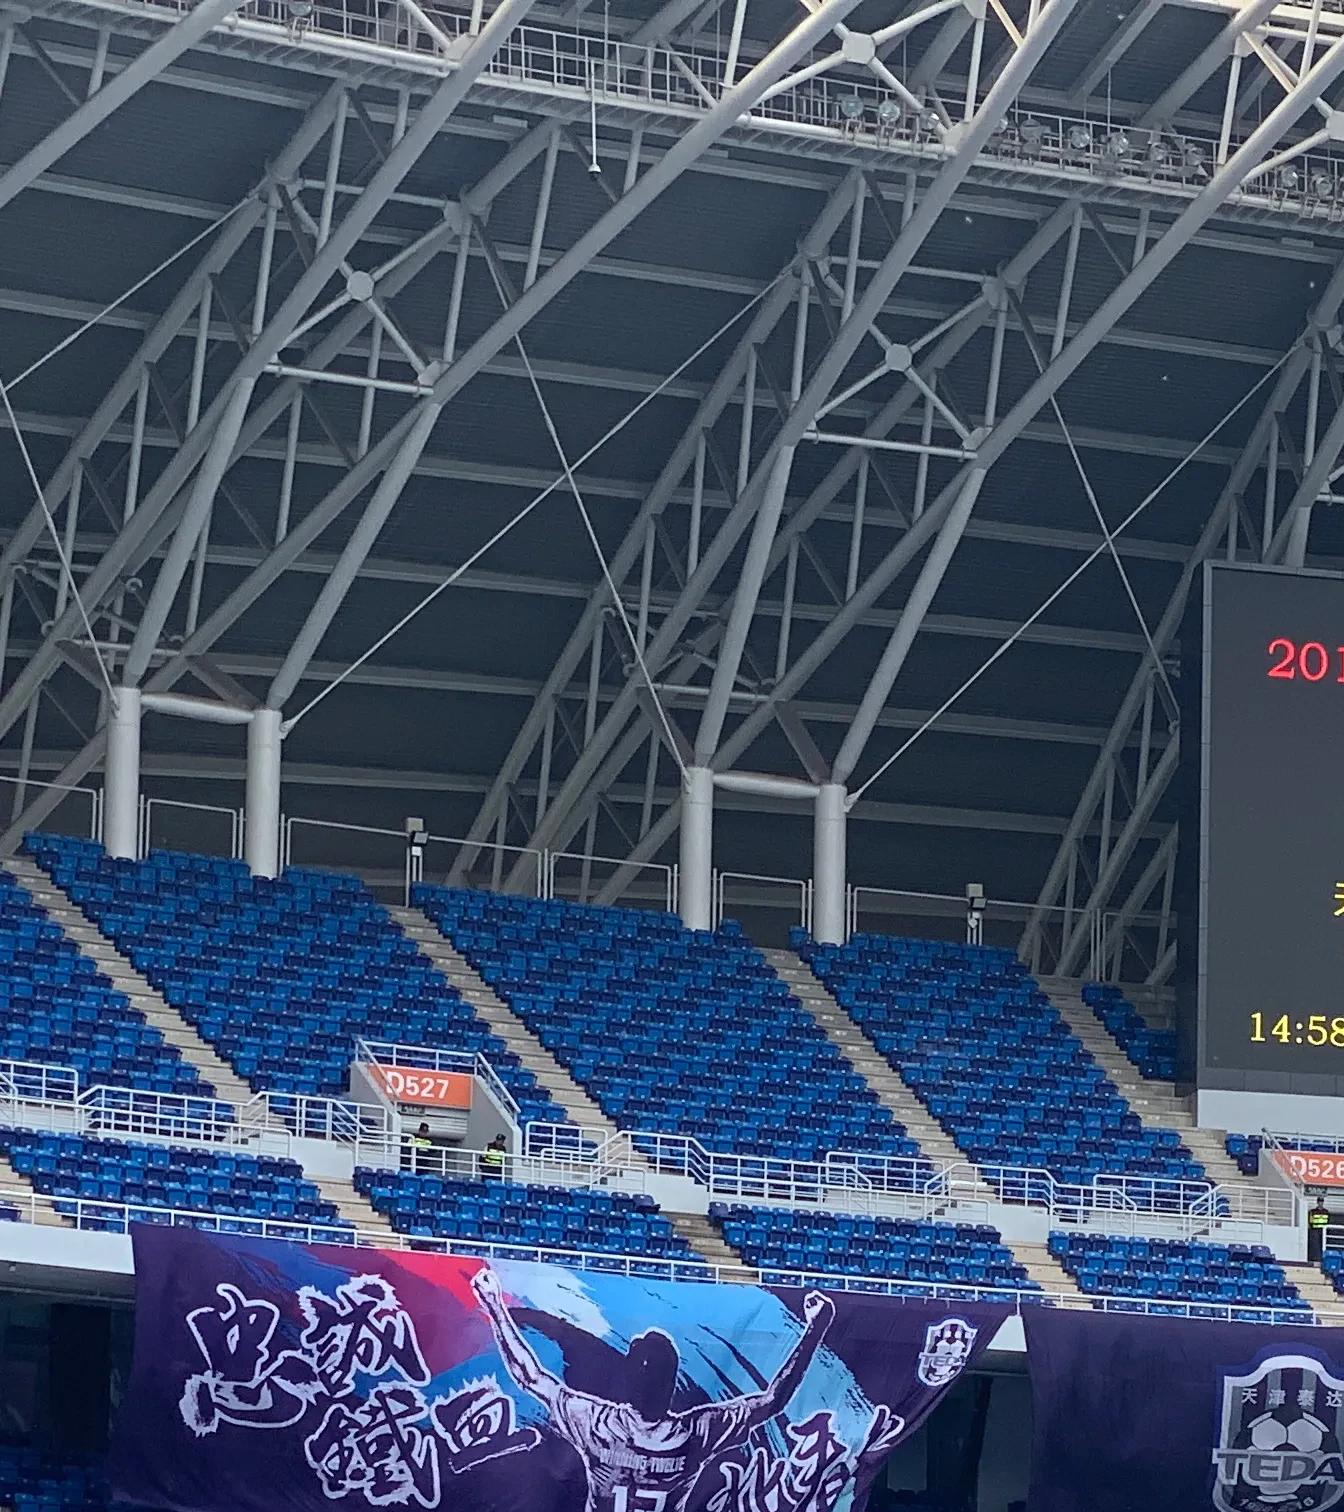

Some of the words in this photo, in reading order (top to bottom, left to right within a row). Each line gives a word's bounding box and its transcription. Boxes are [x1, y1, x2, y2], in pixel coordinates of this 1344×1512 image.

[385, 1071, 449, 1099] D527
[1241, 1387, 1343, 1407] 天津泰达
